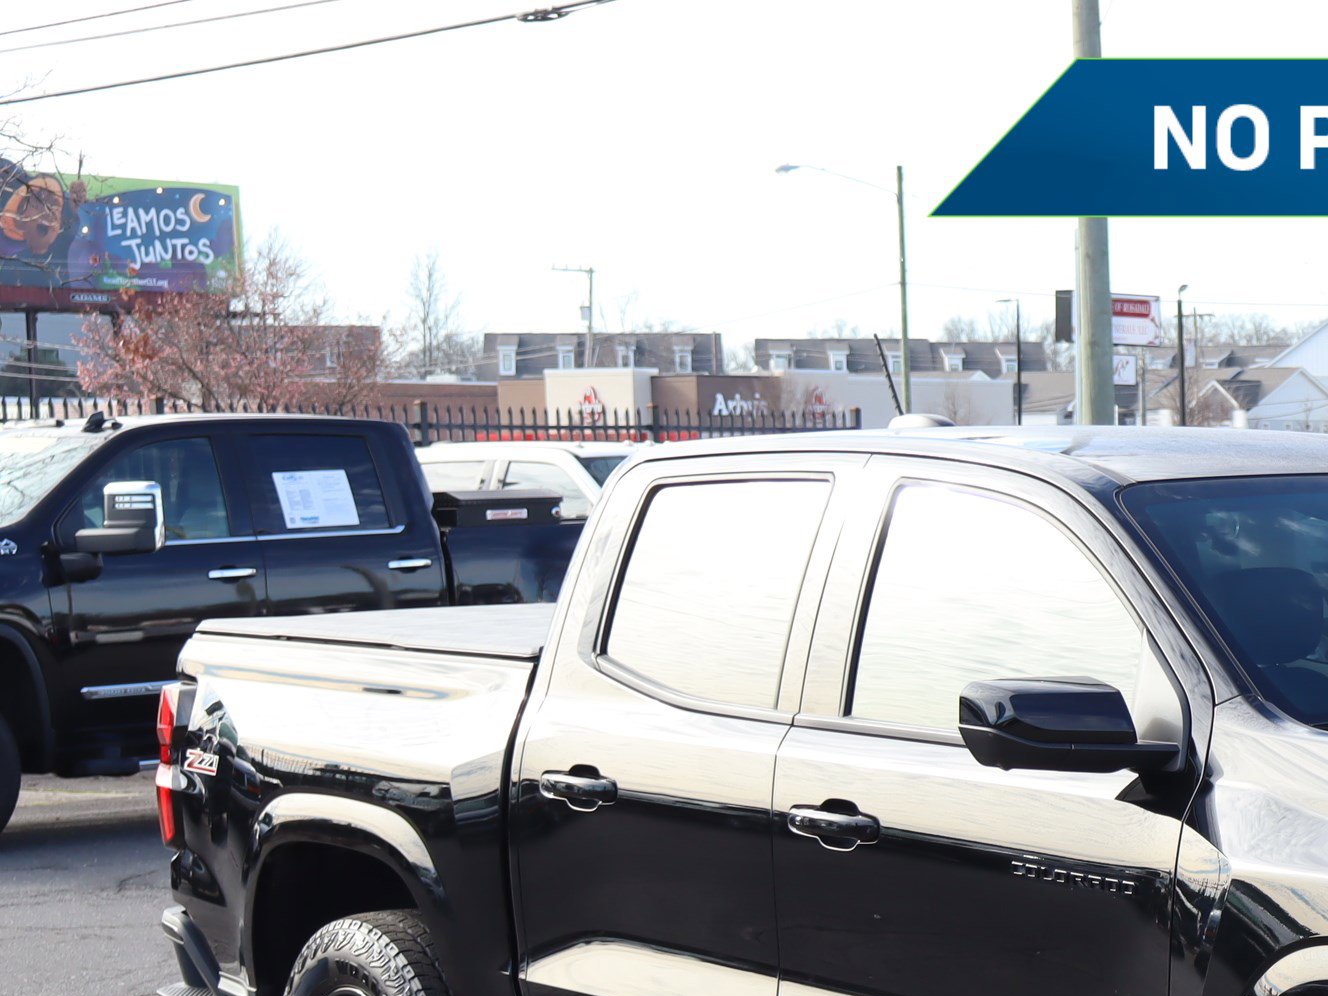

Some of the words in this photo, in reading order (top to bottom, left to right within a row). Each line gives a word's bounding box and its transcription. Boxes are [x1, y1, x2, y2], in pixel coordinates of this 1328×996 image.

[106, 206, 191, 237] LEAMOS
[121, 238, 215, 271] JUNTOS
[183, 748, 220, 777] Z71
